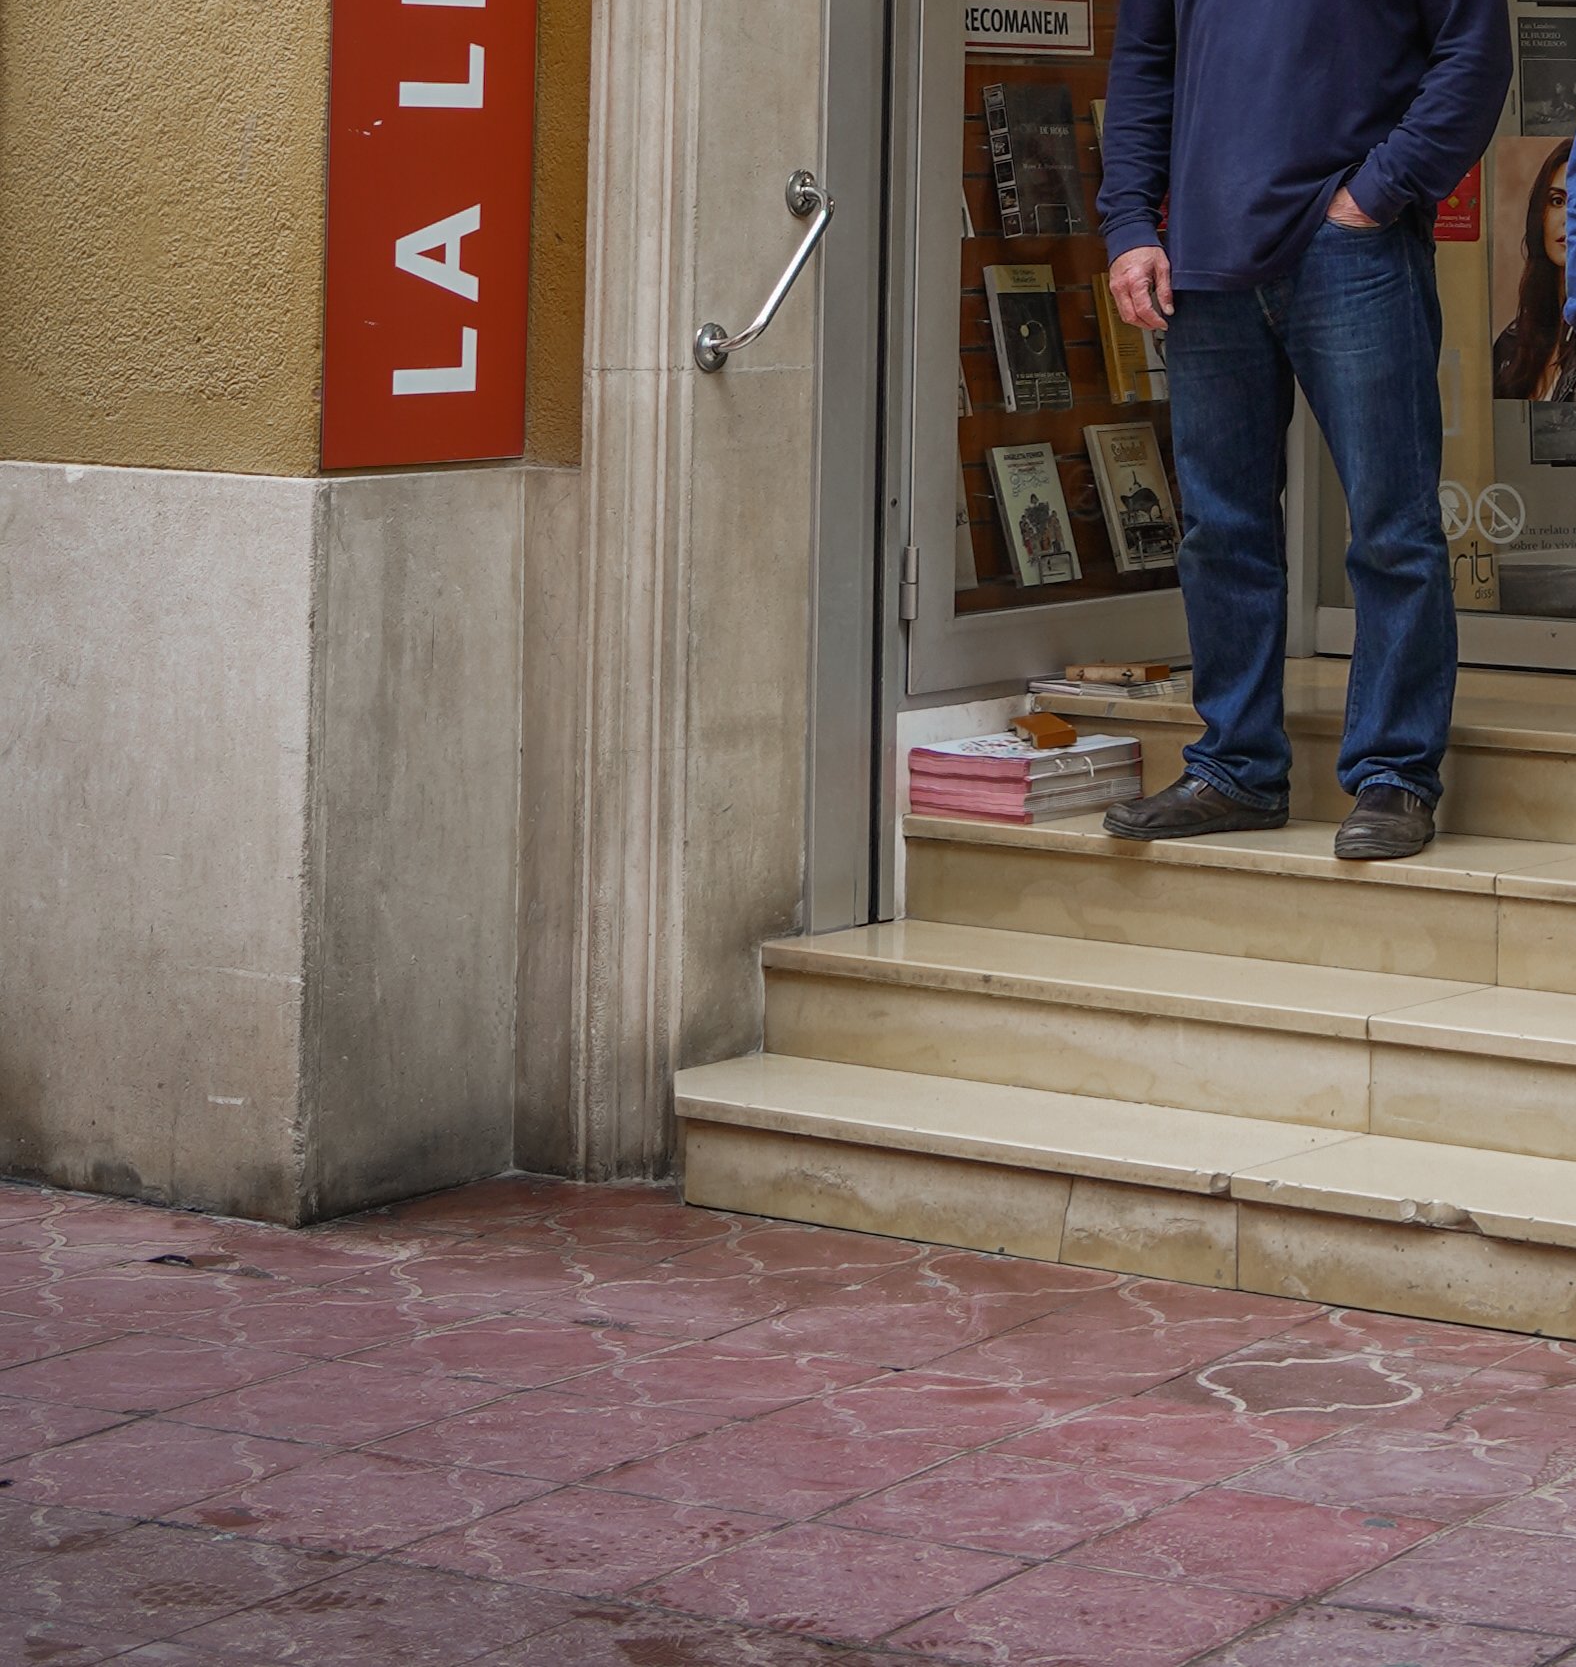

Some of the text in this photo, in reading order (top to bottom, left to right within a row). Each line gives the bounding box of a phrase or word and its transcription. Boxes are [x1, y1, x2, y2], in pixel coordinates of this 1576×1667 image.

[392, 203, 481, 396] LA
[1539, 525, 1570, 536] relato
[1509, 539, 1537, 550] sobre
[1541, 538, 1551, 549] lo
